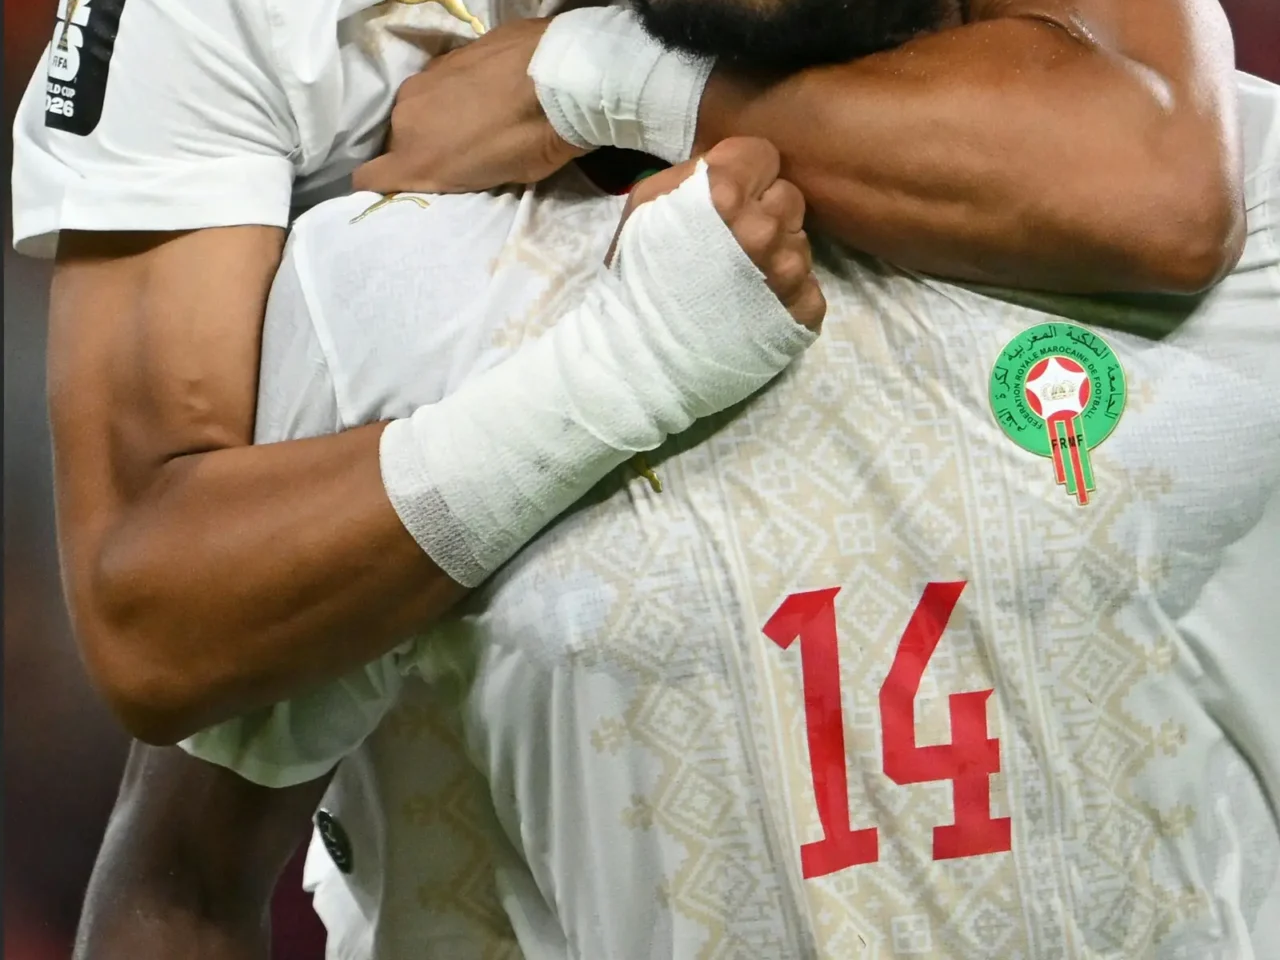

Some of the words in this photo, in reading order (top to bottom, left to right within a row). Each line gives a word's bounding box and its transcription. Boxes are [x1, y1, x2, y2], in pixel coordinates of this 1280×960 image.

[1003, 325, 1057, 362] المغربية
[1039, 345, 1089, 365] MAROCAINE
[1066, 325, 1109, 360] الملكية
[1015, 351, 1039, 381] ROYALE
[1087, 363, 1098, 375] DE
[1013, 382, 1043, 430] FEDERATION
[1084, 376, 1102, 419] FOOTBALL
[1051, 434, 1084, 450] FRMF
[762, 580, 1012, 880] 14
